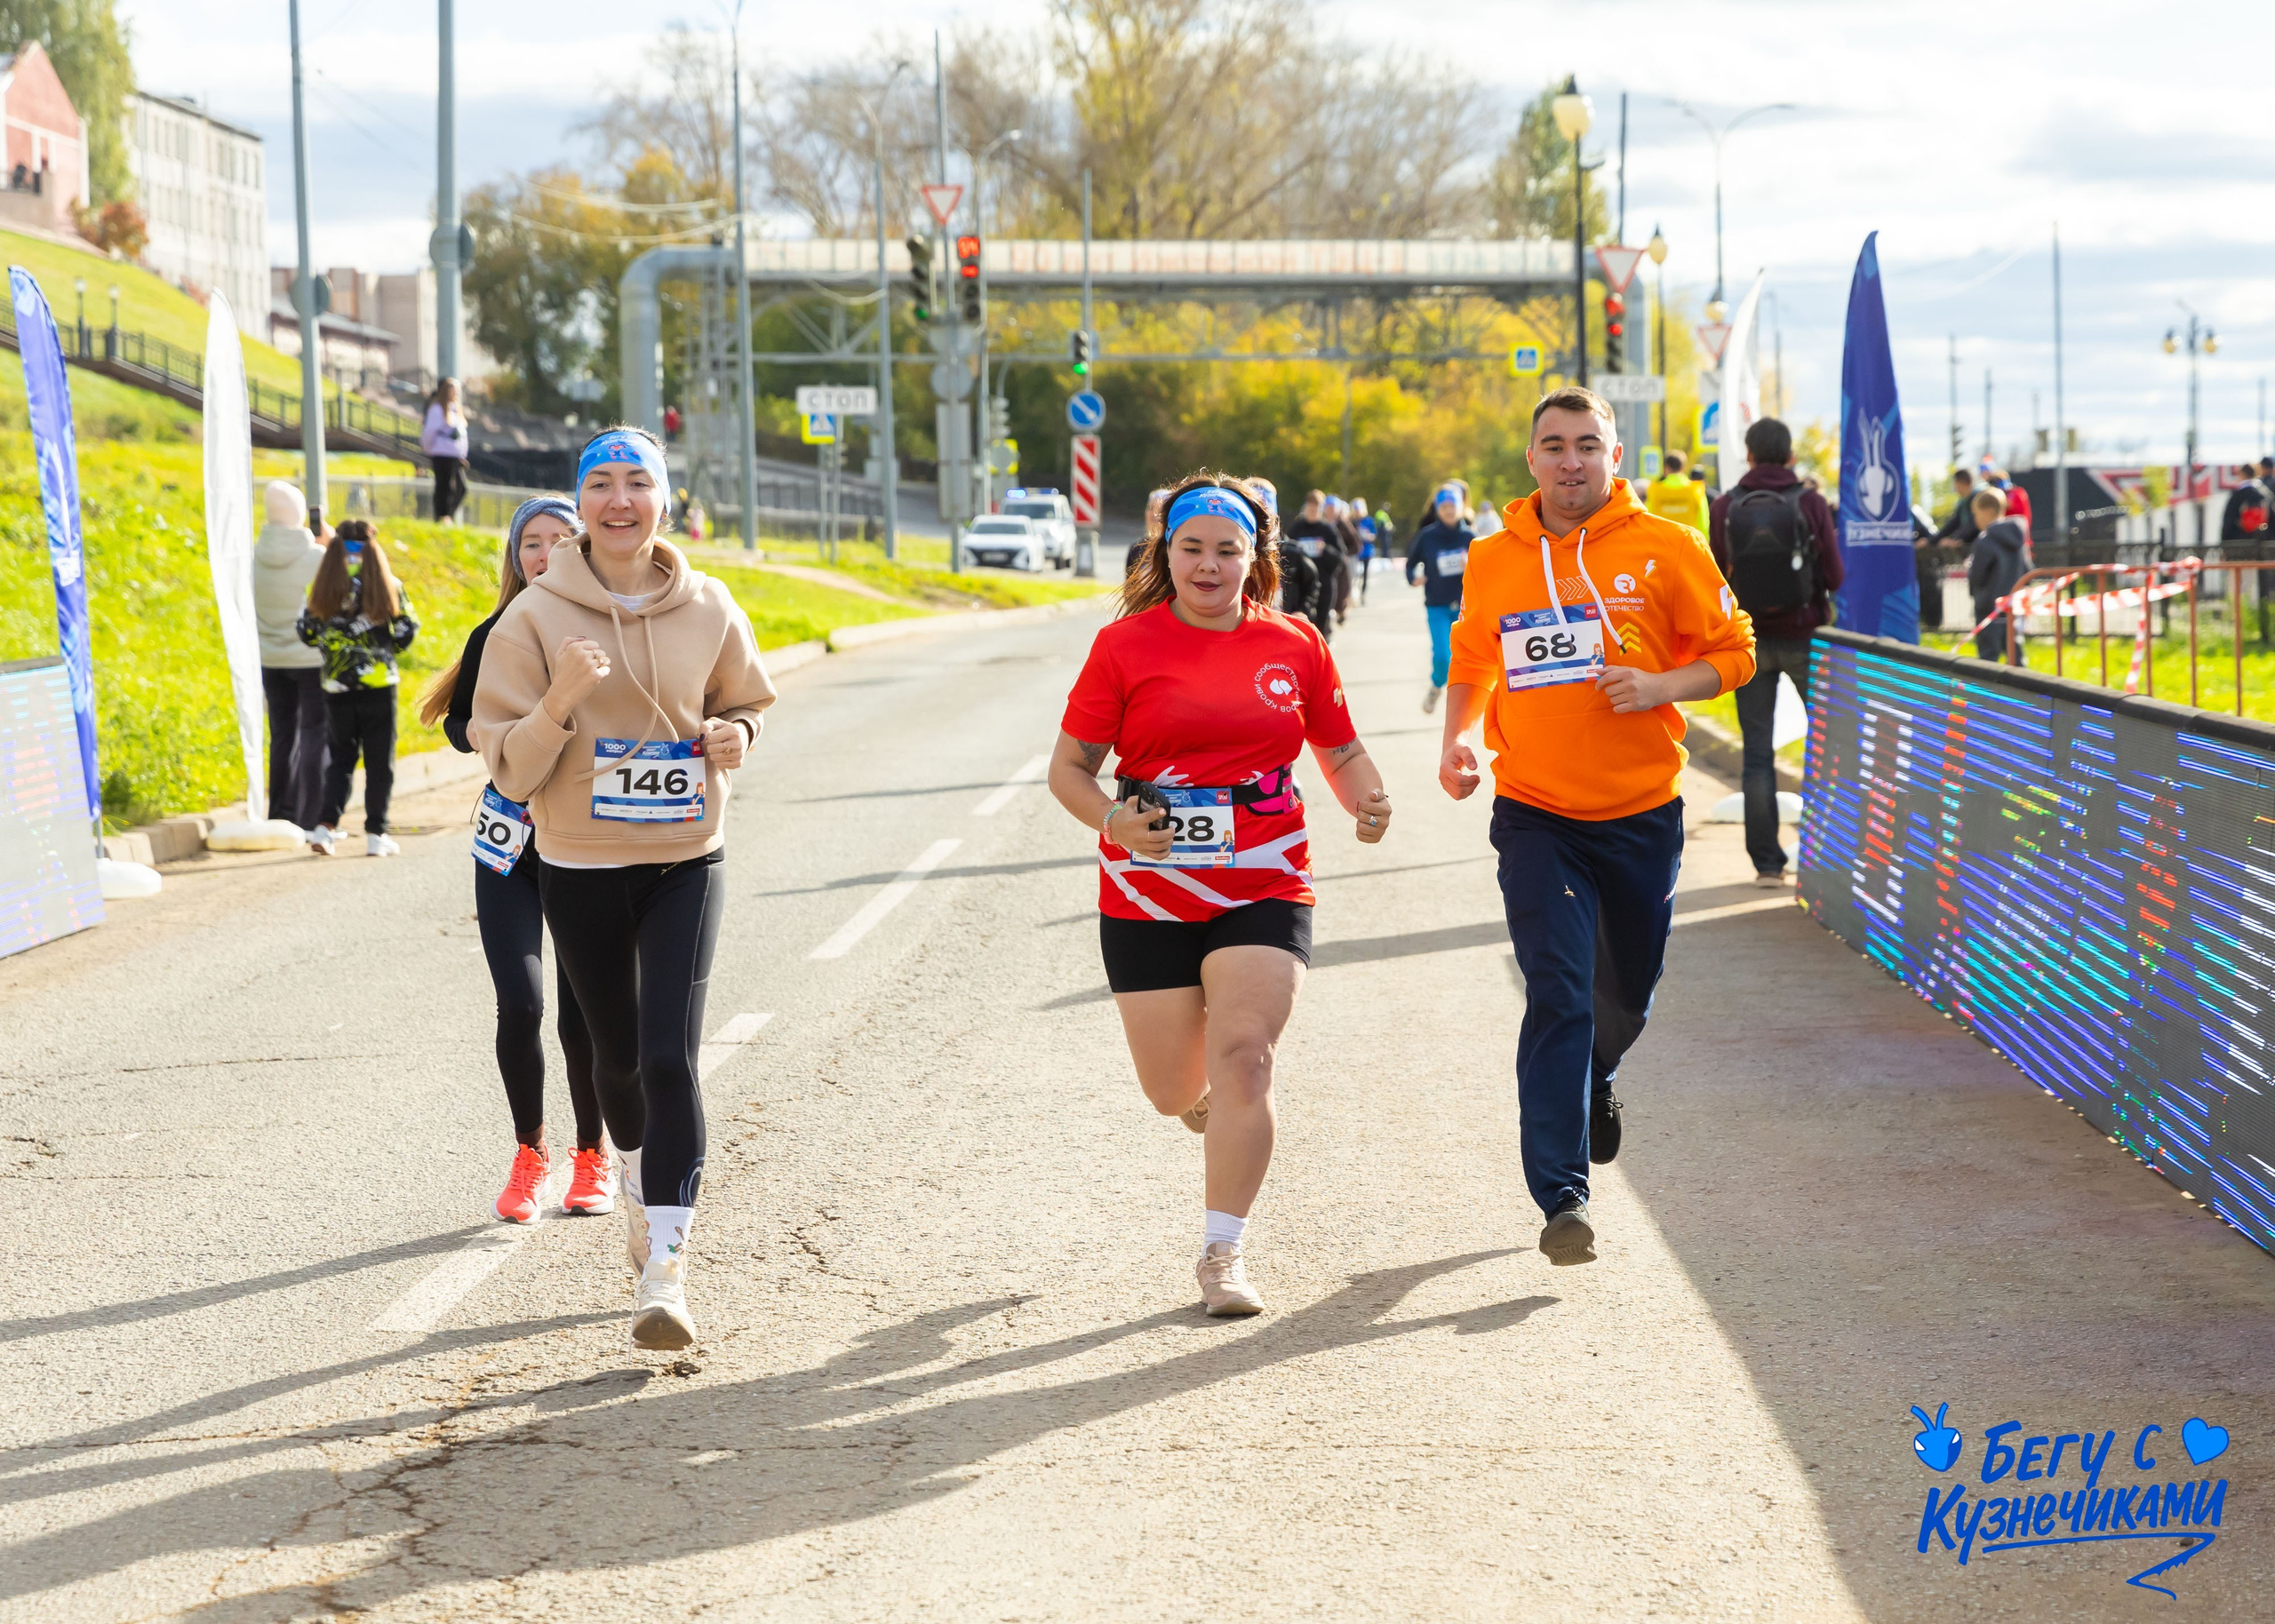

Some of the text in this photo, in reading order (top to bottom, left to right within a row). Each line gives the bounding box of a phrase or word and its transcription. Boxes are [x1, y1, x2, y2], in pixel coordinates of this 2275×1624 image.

[1526, 633, 1577, 662] 68
[1254, 663, 1298, 687] сообщество
[1255, 683, 1278, 710] крови
[616, 768, 688, 795] 146
